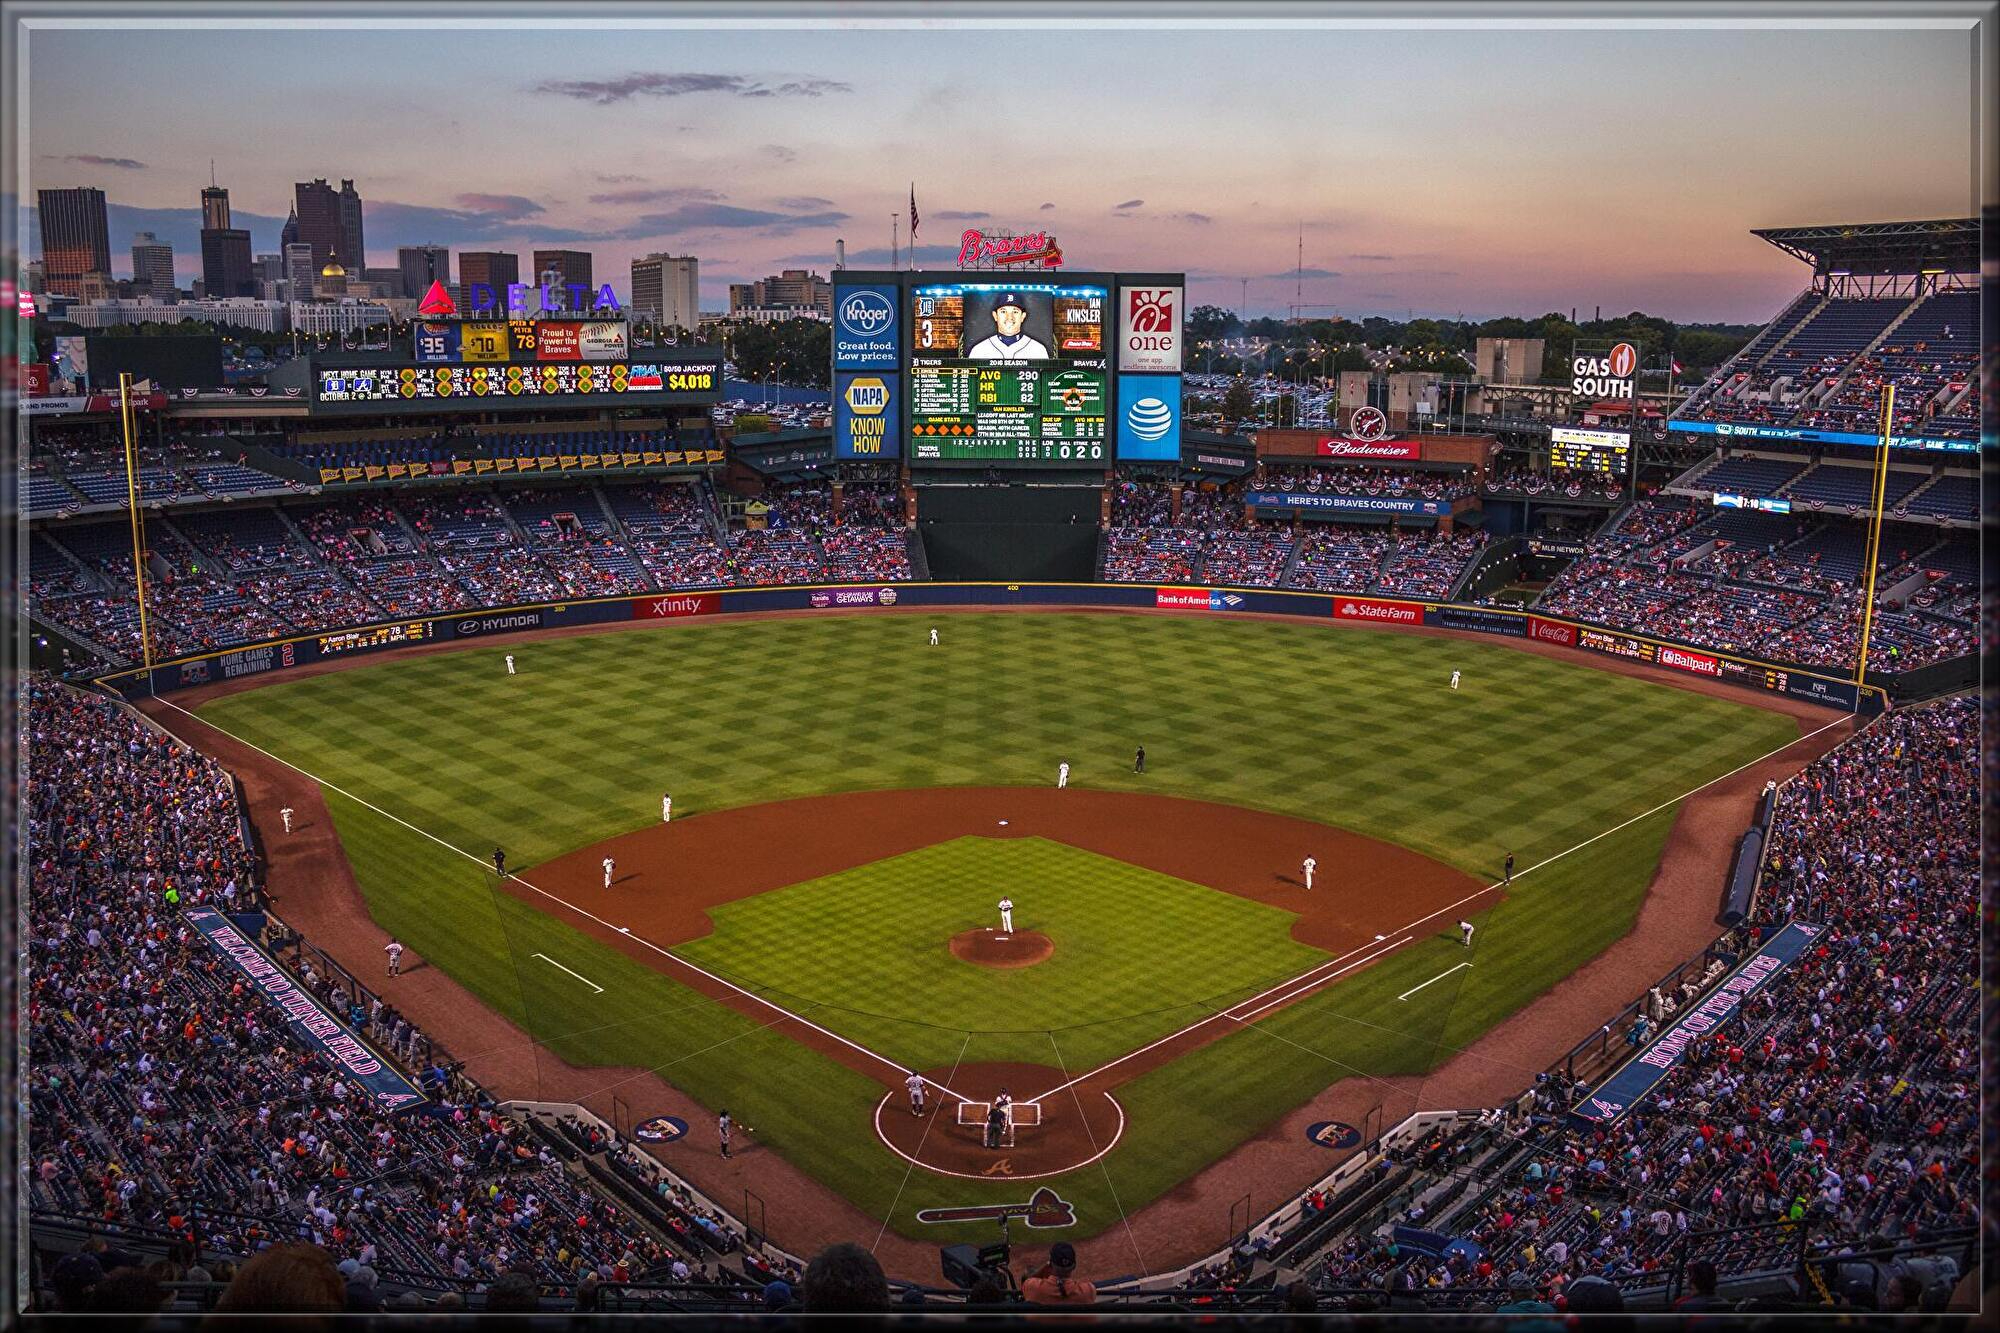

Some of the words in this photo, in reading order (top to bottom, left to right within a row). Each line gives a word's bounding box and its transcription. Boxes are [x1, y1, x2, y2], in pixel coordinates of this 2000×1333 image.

[957, 229, 1046, 265] Braves
[471, 283, 621, 311] DELTA
[1090, 298, 1101, 308] IAN
[846, 299, 888, 330] Kroger
[1067, 309, 1101, 323] KINSLER
[542, 328, 565, 337] Proud
[565, 328, 574, 337] to
[921, 320, 933, 348] 3
[420, 337, 445, 354] $35
[470, 337, 495, 353] $70
[516, 334, 536, 349] 78
[538, 336, 565, 346] Power
[565, 336, 578, 346] the
[838, 341, 868, 350] Great
[869, 341, 896, 350] food.
[1129, 336, 1173, 351] one
[545, 345, 573, 354] Braves
[837, 351, 861, 361] Low
[861, 351, 897, 362] prices.
[322, 371, 340, 379] NEXT
[340, 370, 359, 378] HOME
[359, 370, 377, 378] GAME
[683, 365, 716, 373] JACKPOT
[1573, 357, 1610, 376] GAS
[669, 374, 711, 390] $4,018
[980, 371, 1001, 380] AVG
[1016, 371, 1039, 381] .290
[980, 382, 995, 391] HR
[1020, 382, 1034, 392] 28
[1572, 378, 1633, 398] SOUTH
[320, 392, 350, 401] OCTOBER
[852, 387, 884, 406] NAPA
[980, 394, 997, 403] RBI
[1020, 394, 1034, 403] 82
[41, 402, 69, 410] PROMOS
[850, 418, 886, 435] KNOW
[1734, 427, 1757, 436] SOUTH
[853, 436, 881, 454] HOW
[1060, 446, 1071, 459] 0
[1076, 446, 1086, 459] 2
[1091, 446, 1101, 459] 0
[1327, 441, 1410, 456] Budweiser
[1287, 496, 1319, 505] HERE'S
[1320, 498, 1332, 506] TO
[1334, 499, 1370, 508] BRAVES
[1371, 500, 1415, 510] COUNTRY
[1556, 546, 1585, 554] NETWOR
[652, 596, 702, 617] xfinity
[836, 596, 873, 604] GETAWAYS
[1158, 595, 1178, 603] Bank
[1179, 595, 1187, 604] of
[1187, 596, 1221, 605] America
[1359, 604, 1387, 617] State
[1388, 607, 1416, 620] Farm
[482, 614, 539, 631] HYUNDAI
[390, 627, 401, 635] 78
[1588, 632, 1602, 640] Aaron
[1628, 640, 1638, 650] 78
[220, 653, 244, 667] HOME
[245, 647, 274, 661] GAMES
[282, 643, 295, 667] 2
[1626, 649, 1640, 657] MPH
[225, 660, 271, 677] REMAINING
[1673, 653, 1715, 673] Ballpark
[1725, 661, 1746, 672] Kinsler
[1790, 687, 1821, 699] NORTHSIDE
[1821, 694, 1848, 705] HOSPITAL
[1860, 688, 1873, 697] 330
[208, 926, 278, 978] WELCOME
[1723, 954, 1782, 994] BRAVES
[258, 975, 291, 992] TO
[1697, 991, 1743, 1017] THE
[274, 988, 341, 1039] TURNER
[1682, 1010, 1717, 1033] OF
[322, 1034, 381, 1075] FIELD
[1639, 1027, 1697, 1069] HOME
